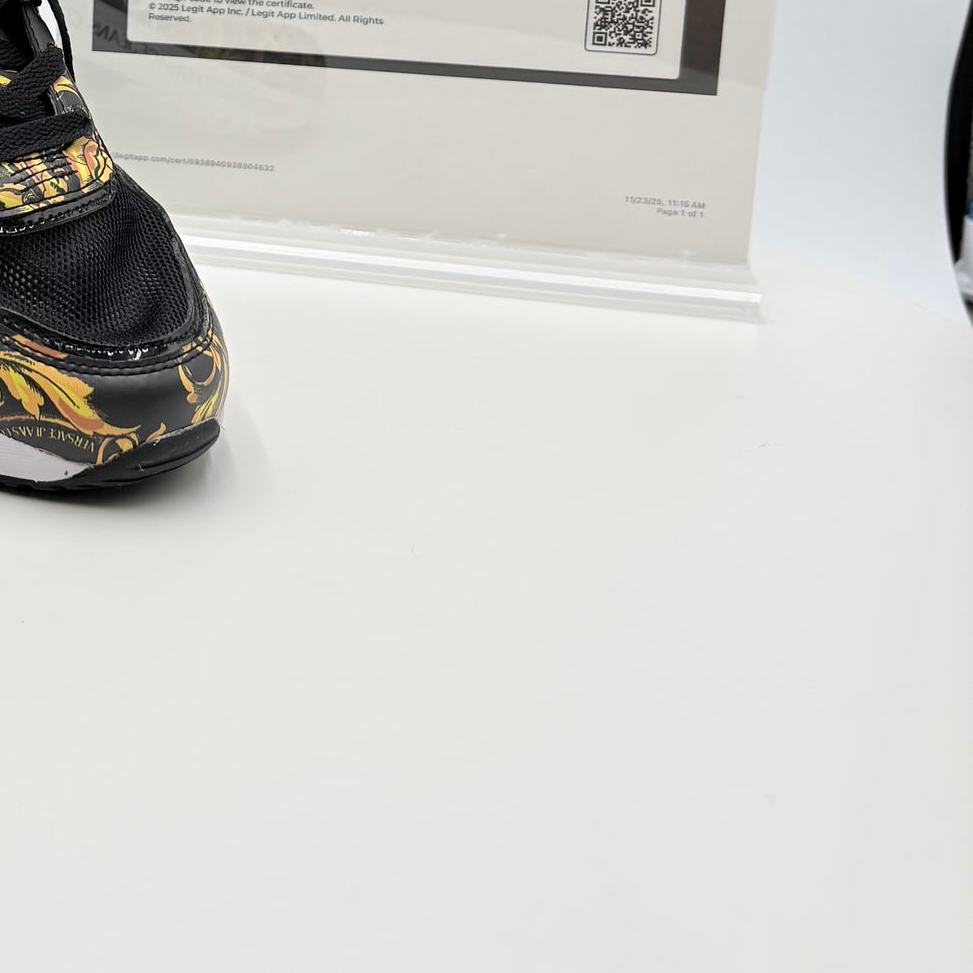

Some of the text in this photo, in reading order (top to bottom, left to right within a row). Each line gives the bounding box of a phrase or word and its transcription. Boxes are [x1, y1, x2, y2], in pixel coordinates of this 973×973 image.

[266, 0, 314, 9] certificate.
[148, 13, 192, 22] Reserved.
[158, 3, 179, 11] 2025
[181, 4, 204, 14] Legit
[206, 6, 225, 15] App
[228, 7, 243, 15] Inc.
[245, 8, 250, 16] /
[251, 9, 275, 18] Legit
[276, 11, 296, 20] App
[298, 12, 336, 22] Limited.
[353, 15, 384, 25] Rights
[625, 195, 705, 209] 11/23/25, 11:15 AM
[657, 207, 678, 216] Page
